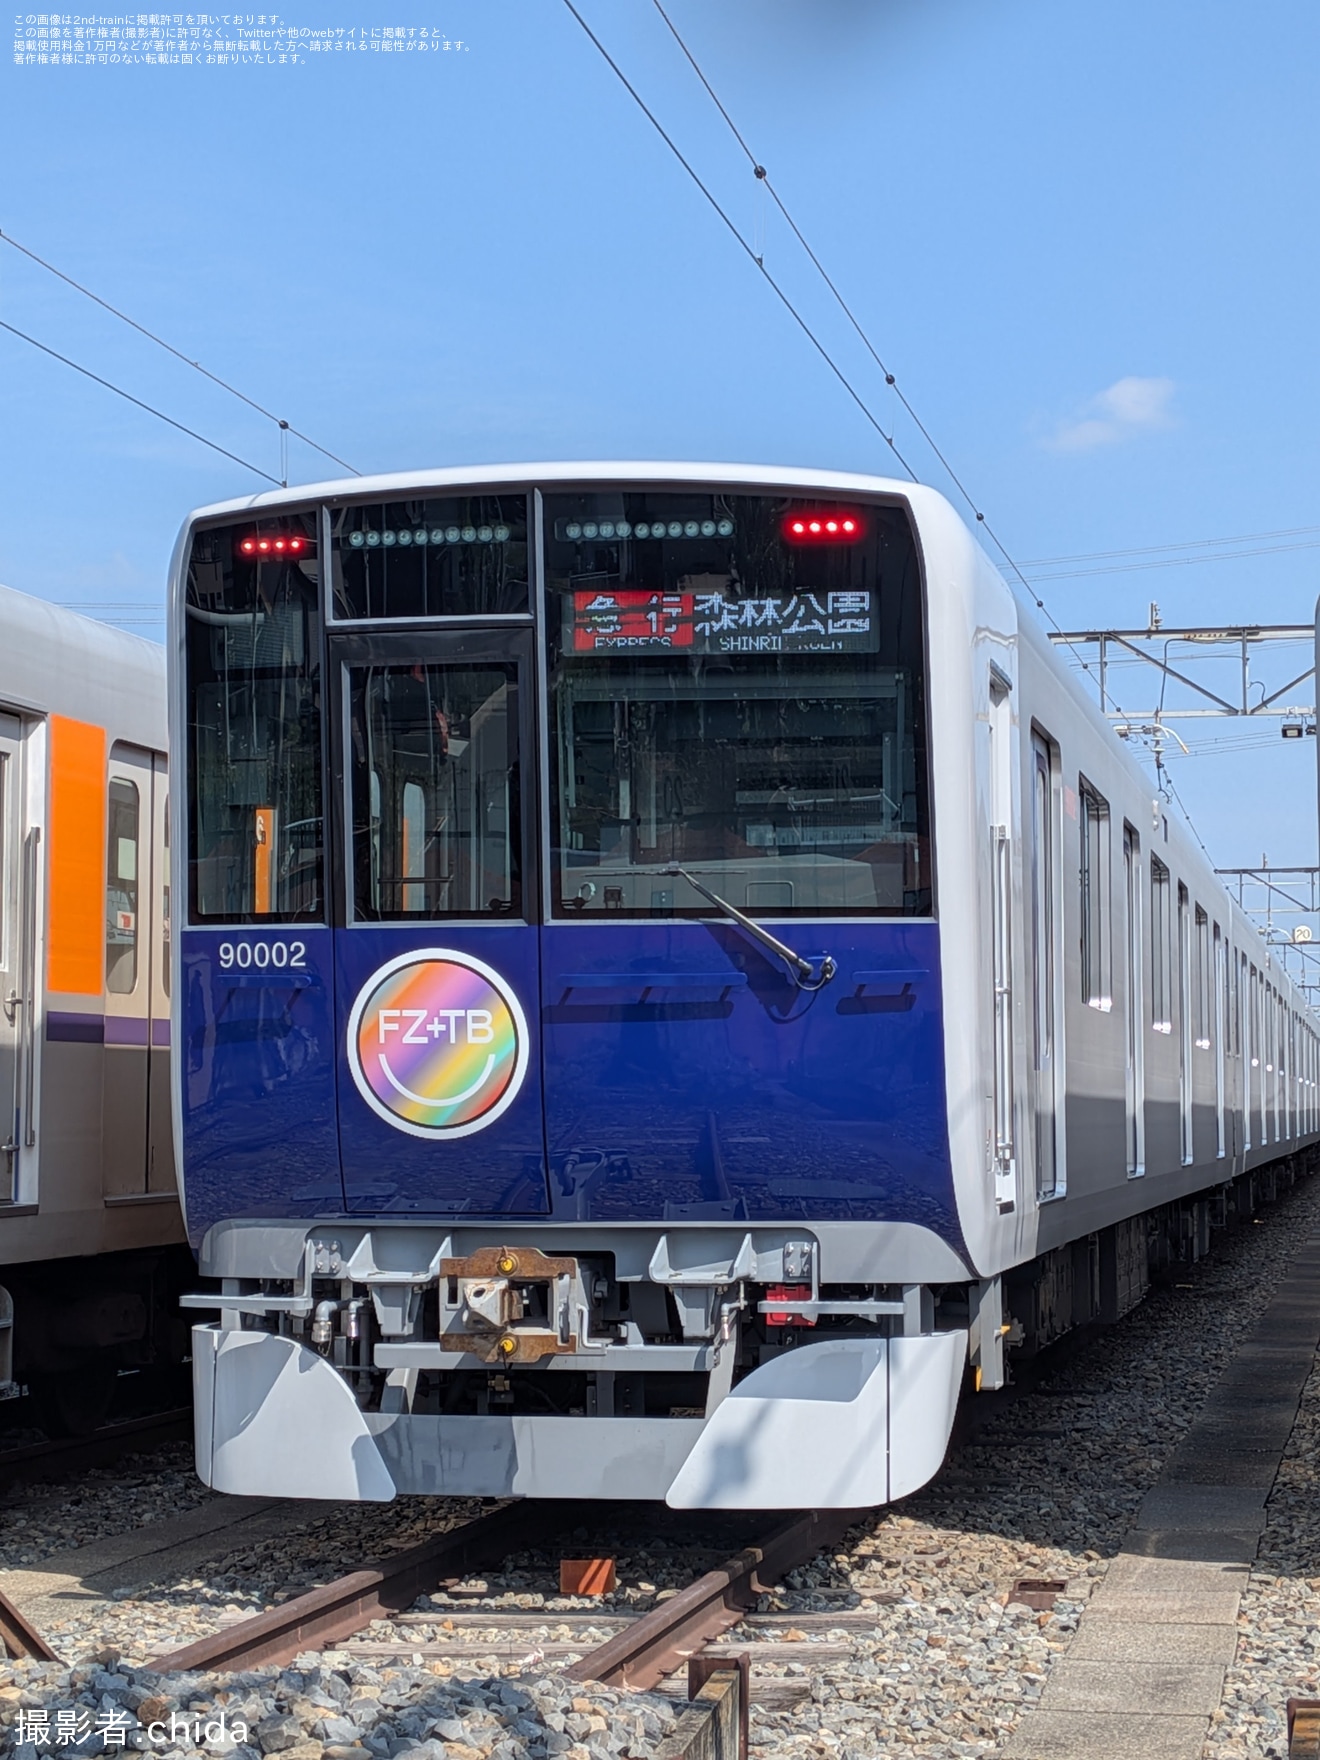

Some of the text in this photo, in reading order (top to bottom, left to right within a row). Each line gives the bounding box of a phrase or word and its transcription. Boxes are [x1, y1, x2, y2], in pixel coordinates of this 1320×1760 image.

[693, 591, 870, 636] 森林公園
[219, 941, 306, 968] 90002
[378, 1009, 495, 1045] FZ+TB
